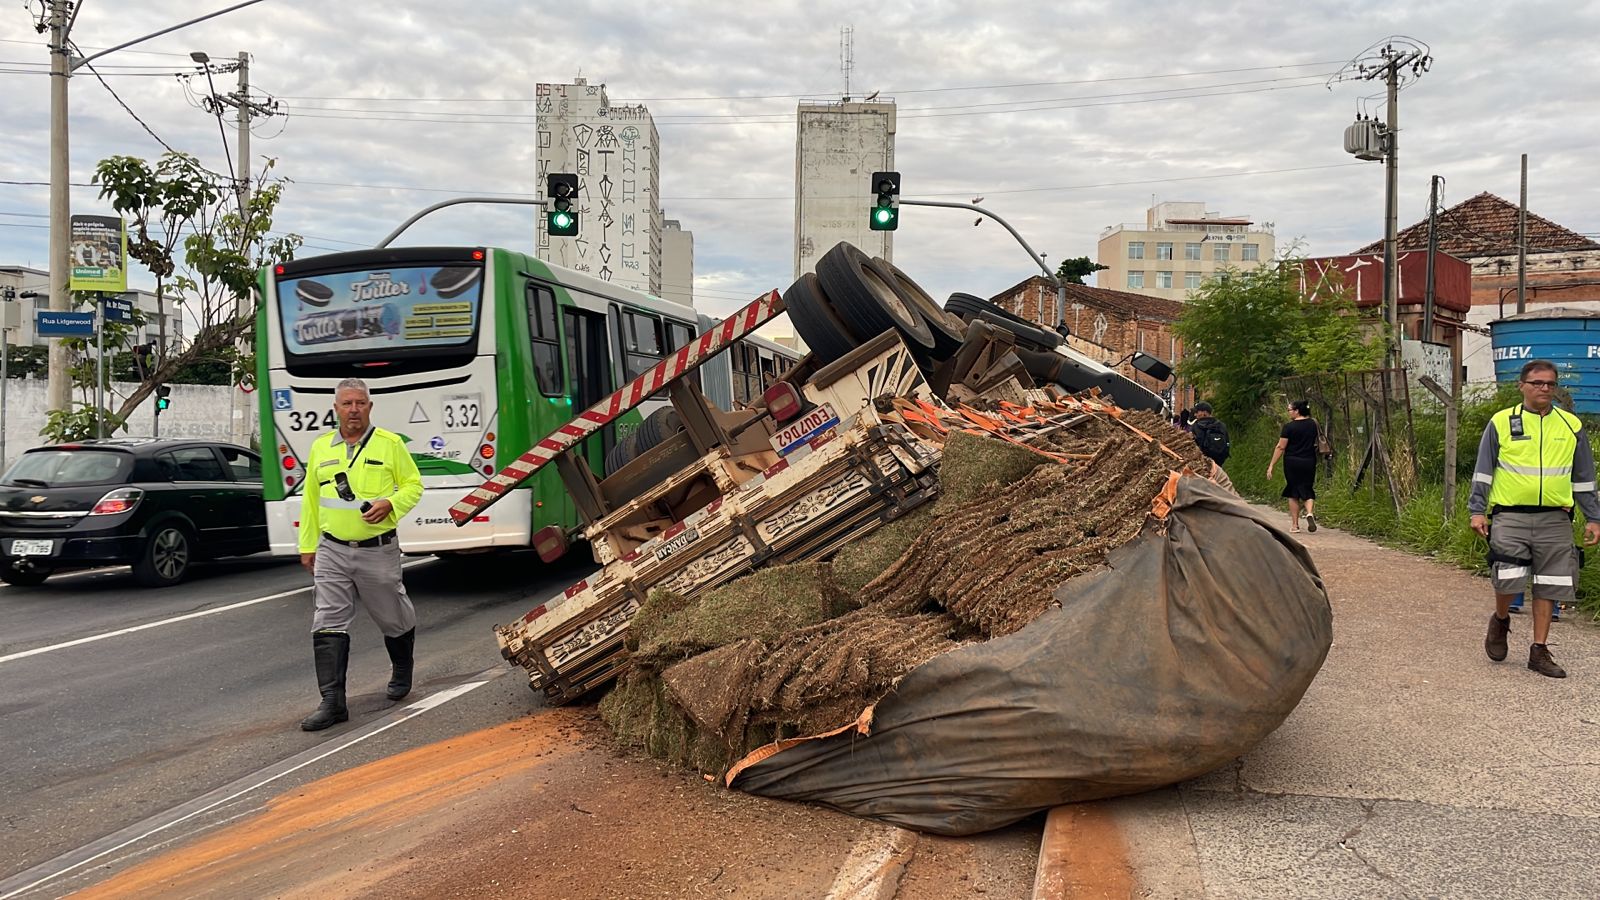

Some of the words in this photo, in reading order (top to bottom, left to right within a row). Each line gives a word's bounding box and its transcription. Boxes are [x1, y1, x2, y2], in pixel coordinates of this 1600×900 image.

[351, 279, 410, 302] Twitter
[56, 318, 91, 326] Lidgerwood
[289, 409, 337, 431] 324
[445, 403, 479, 428] 3.32
[776, 408, 830, 447] EQU7D62
